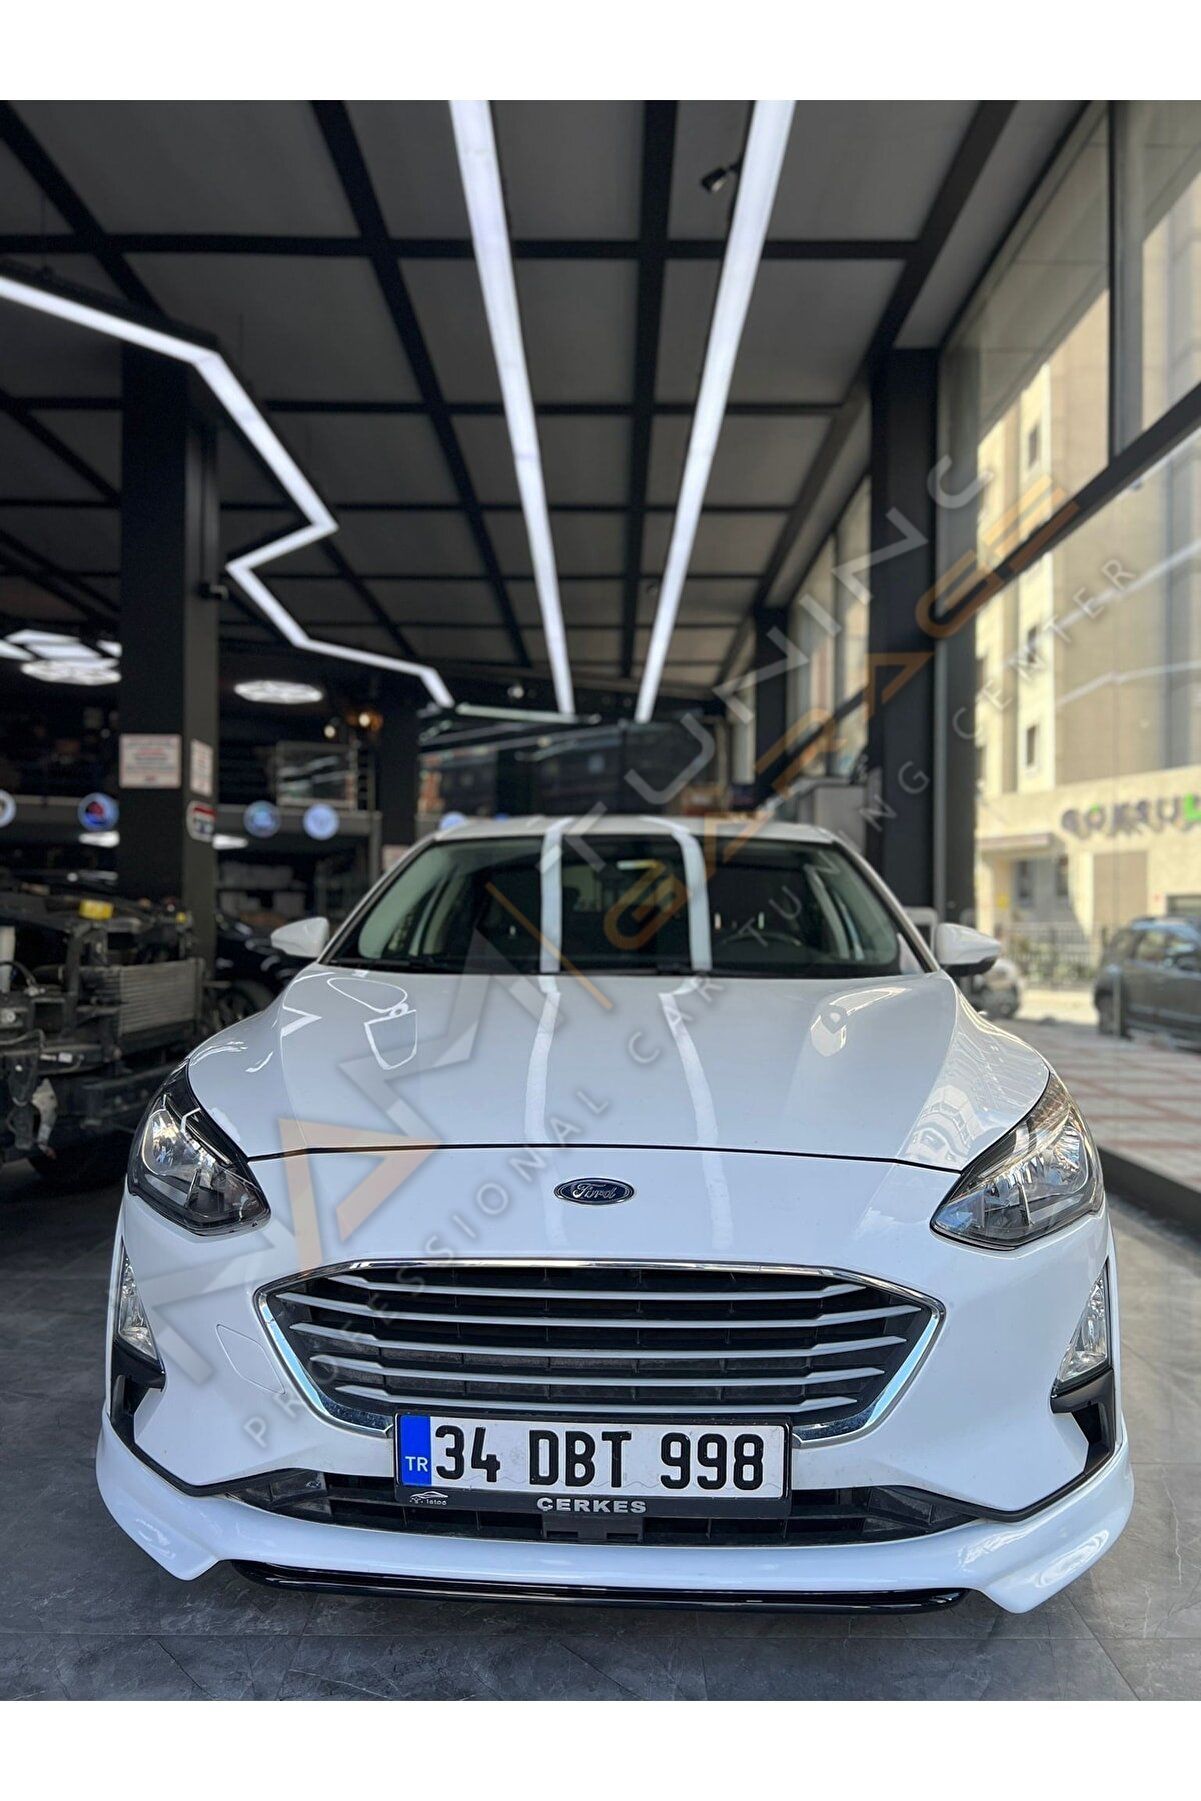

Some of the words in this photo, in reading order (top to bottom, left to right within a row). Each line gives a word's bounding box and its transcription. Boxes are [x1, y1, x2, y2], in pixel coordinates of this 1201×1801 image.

[405, 1456, 428, 1472] TR
[435, 1425, 501, 1482] 34
[529, 1430, 632, 1487] DBT
[660, 1432, 764, 1490] 998
